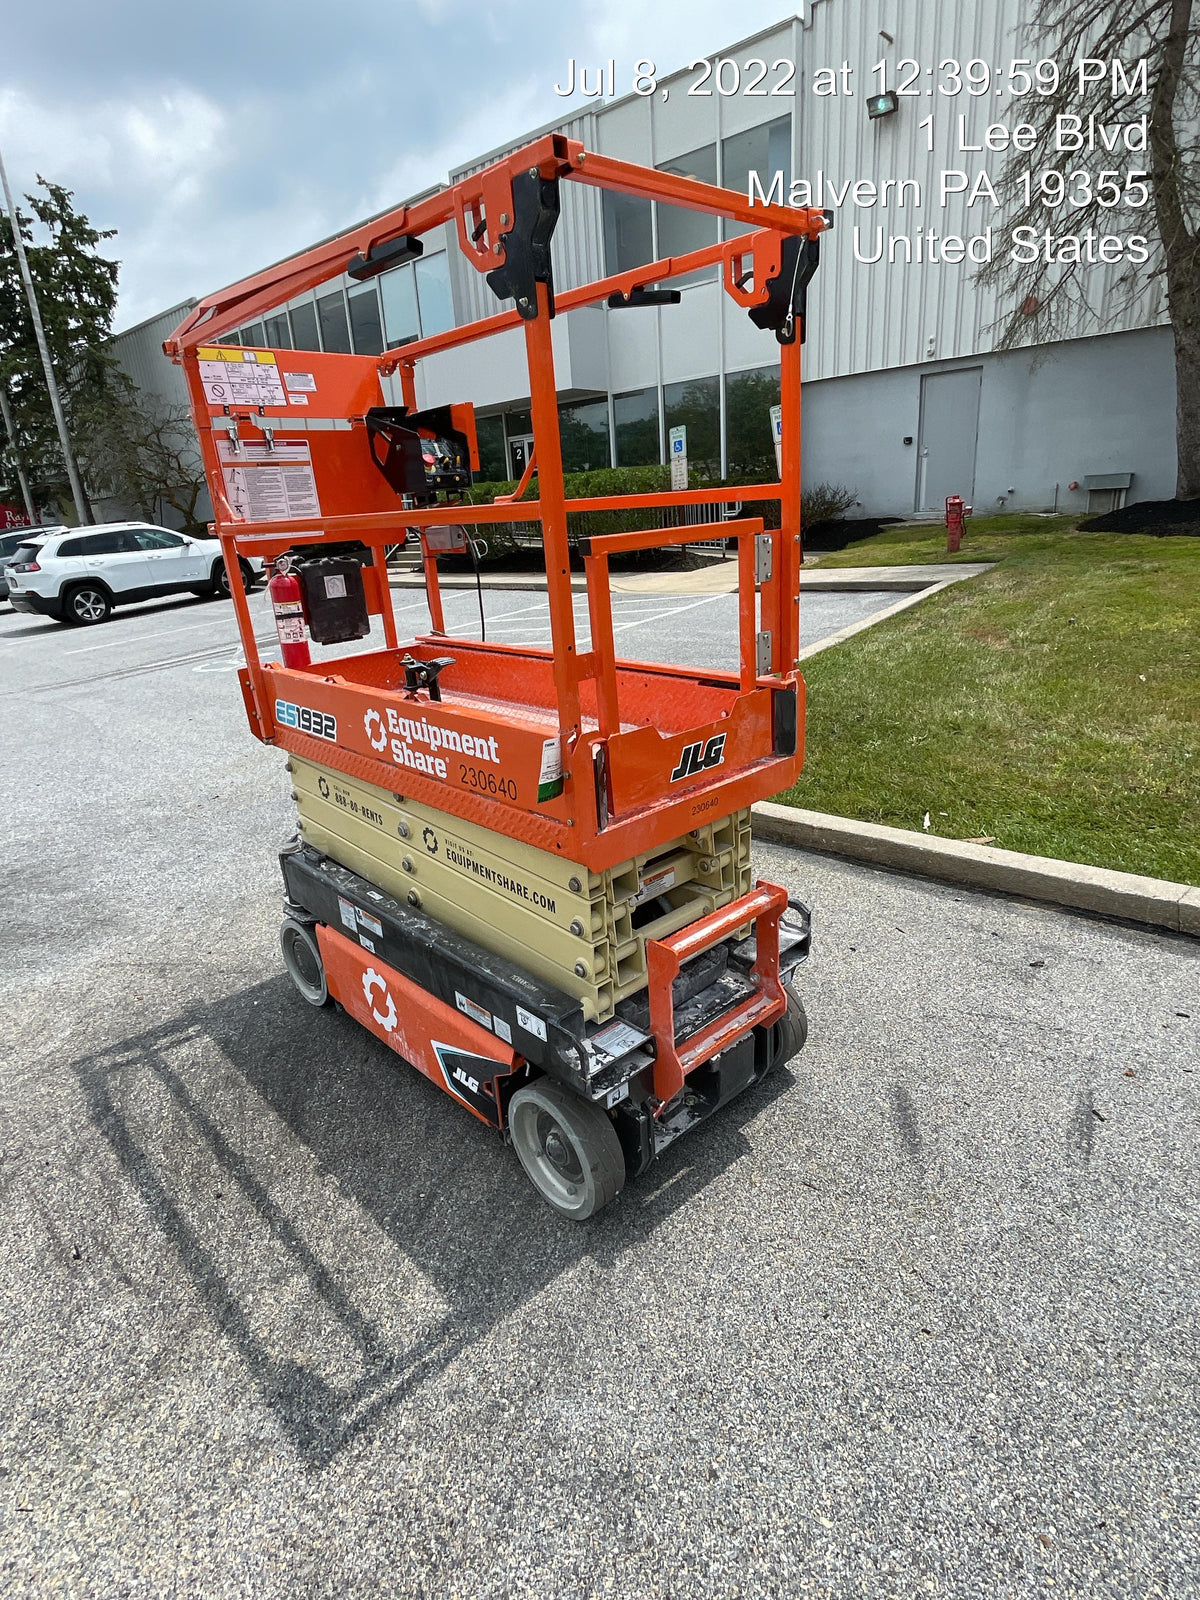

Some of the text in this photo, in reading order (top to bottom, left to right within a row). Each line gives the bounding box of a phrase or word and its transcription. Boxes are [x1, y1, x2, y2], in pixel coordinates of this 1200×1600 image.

[516, 448, 522, 460] 2
[275, 699, 337, 742] ES1932
[386, 708, 500, 763] Equipment
[391, 739, 447, 778] Share
[670, 732, 727, 783] JLG
[459, 764, 517, 800] 230640
[335, 793, 383, 825] 888-80-RENTS
[692, 797, 719, 815] 230640
[446, 848, 556, 914] EQUIPMENTSHARE.COM
[452, 1066, 480, 1094] JLG
